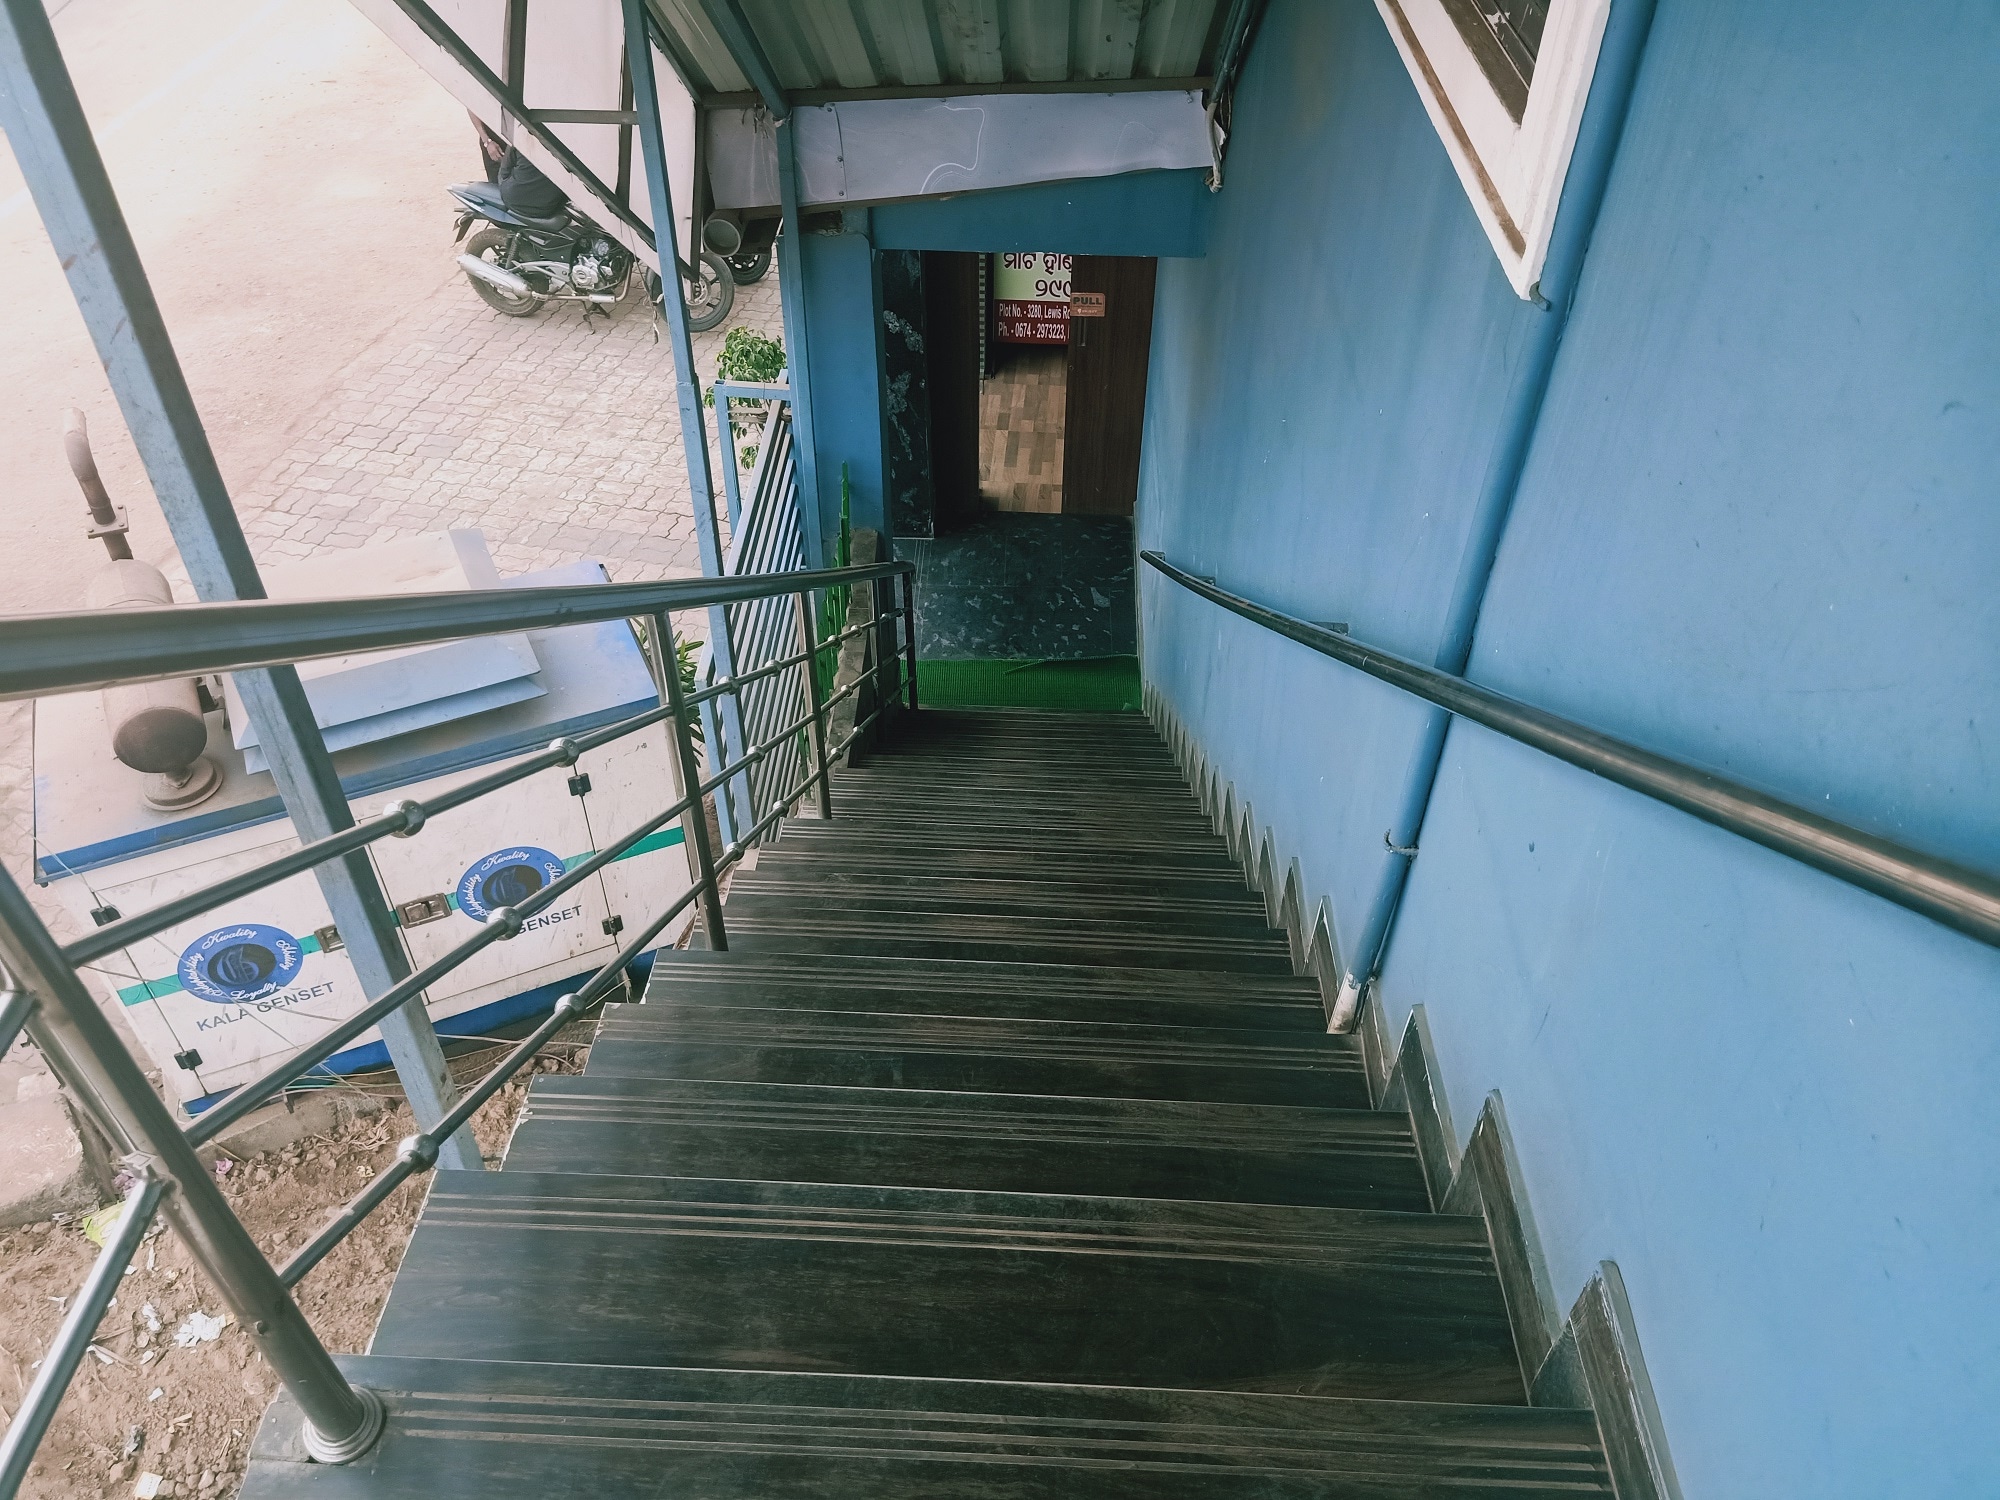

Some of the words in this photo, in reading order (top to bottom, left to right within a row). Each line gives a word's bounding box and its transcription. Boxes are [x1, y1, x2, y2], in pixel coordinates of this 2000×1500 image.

[1073, 296, 1102, 305] PULL
[999, 303, 1011, 317] Plot
[1012, 304, 1023, 317] No.
[1044, 305, 1062, 319] Lewis
[998, 322, 1009, 336] Ph.
[1015, 322, 1031, 338] 0674
[481, 850, 530, 871] Kwality
[202, 927, 257, 949] Kwality
[275, 939, 298, 971] Ability
[230, 981, 278, 1000] Loyalty
[196, 1007, 250, 1032] KALA
[256, 981, 334, 1013] GENSET
